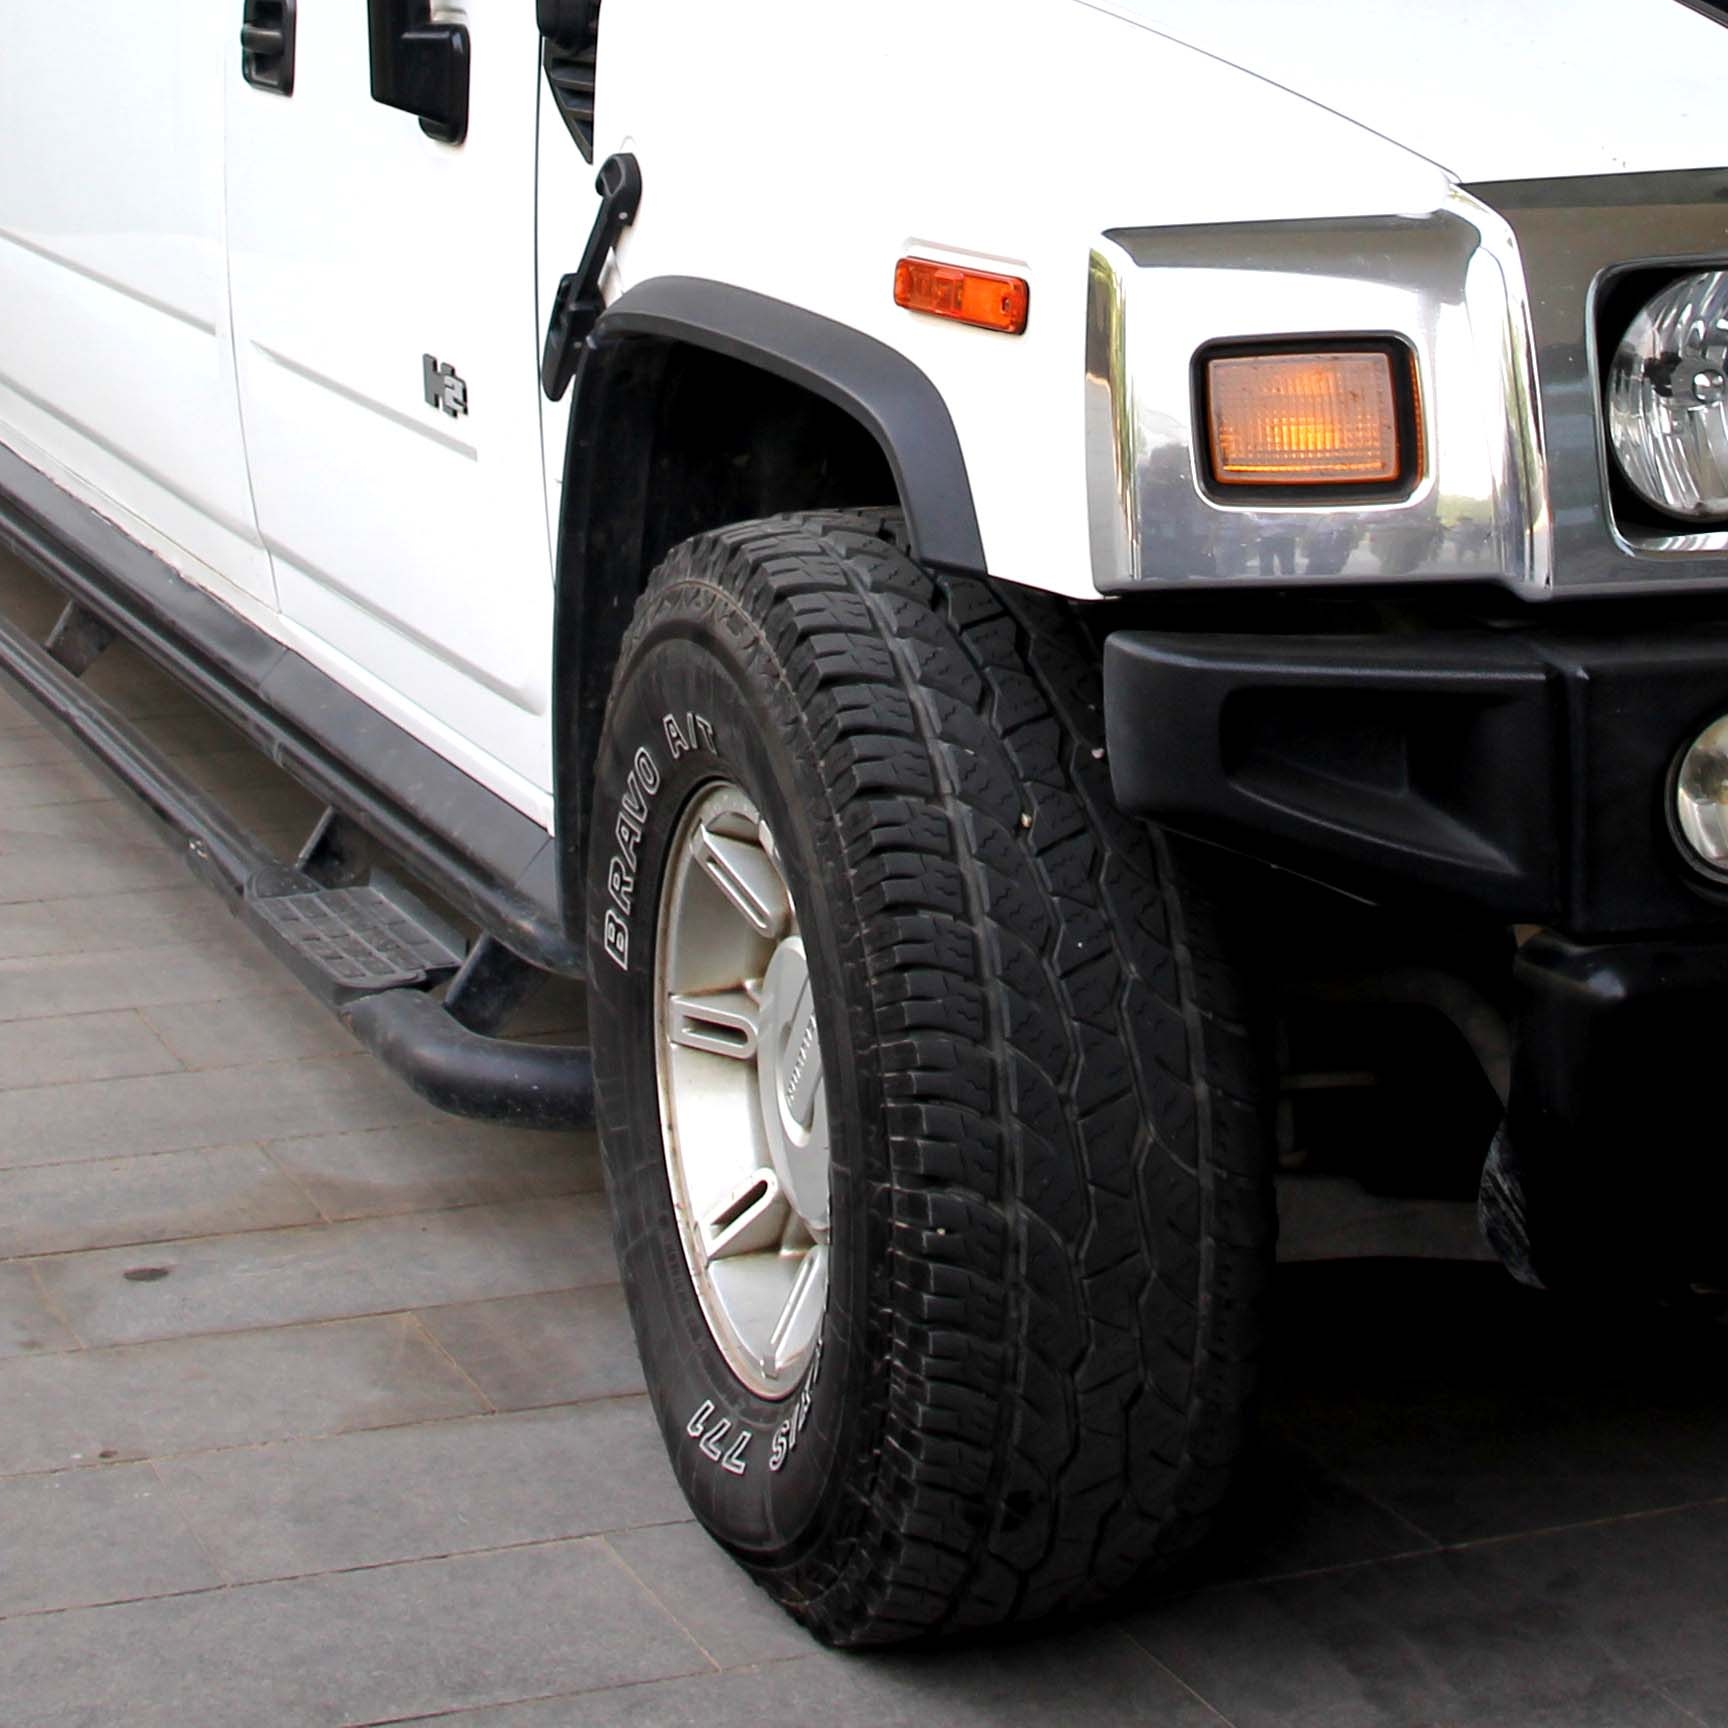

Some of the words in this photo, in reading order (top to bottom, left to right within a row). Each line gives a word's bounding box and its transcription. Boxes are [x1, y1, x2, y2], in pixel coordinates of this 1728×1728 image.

[422, 353, 469, 420] H2
[604, 746, 661, 971] BRAVO
[662, 712, 719, 759] A/T
[686, 1399, 752, 1475] 771
